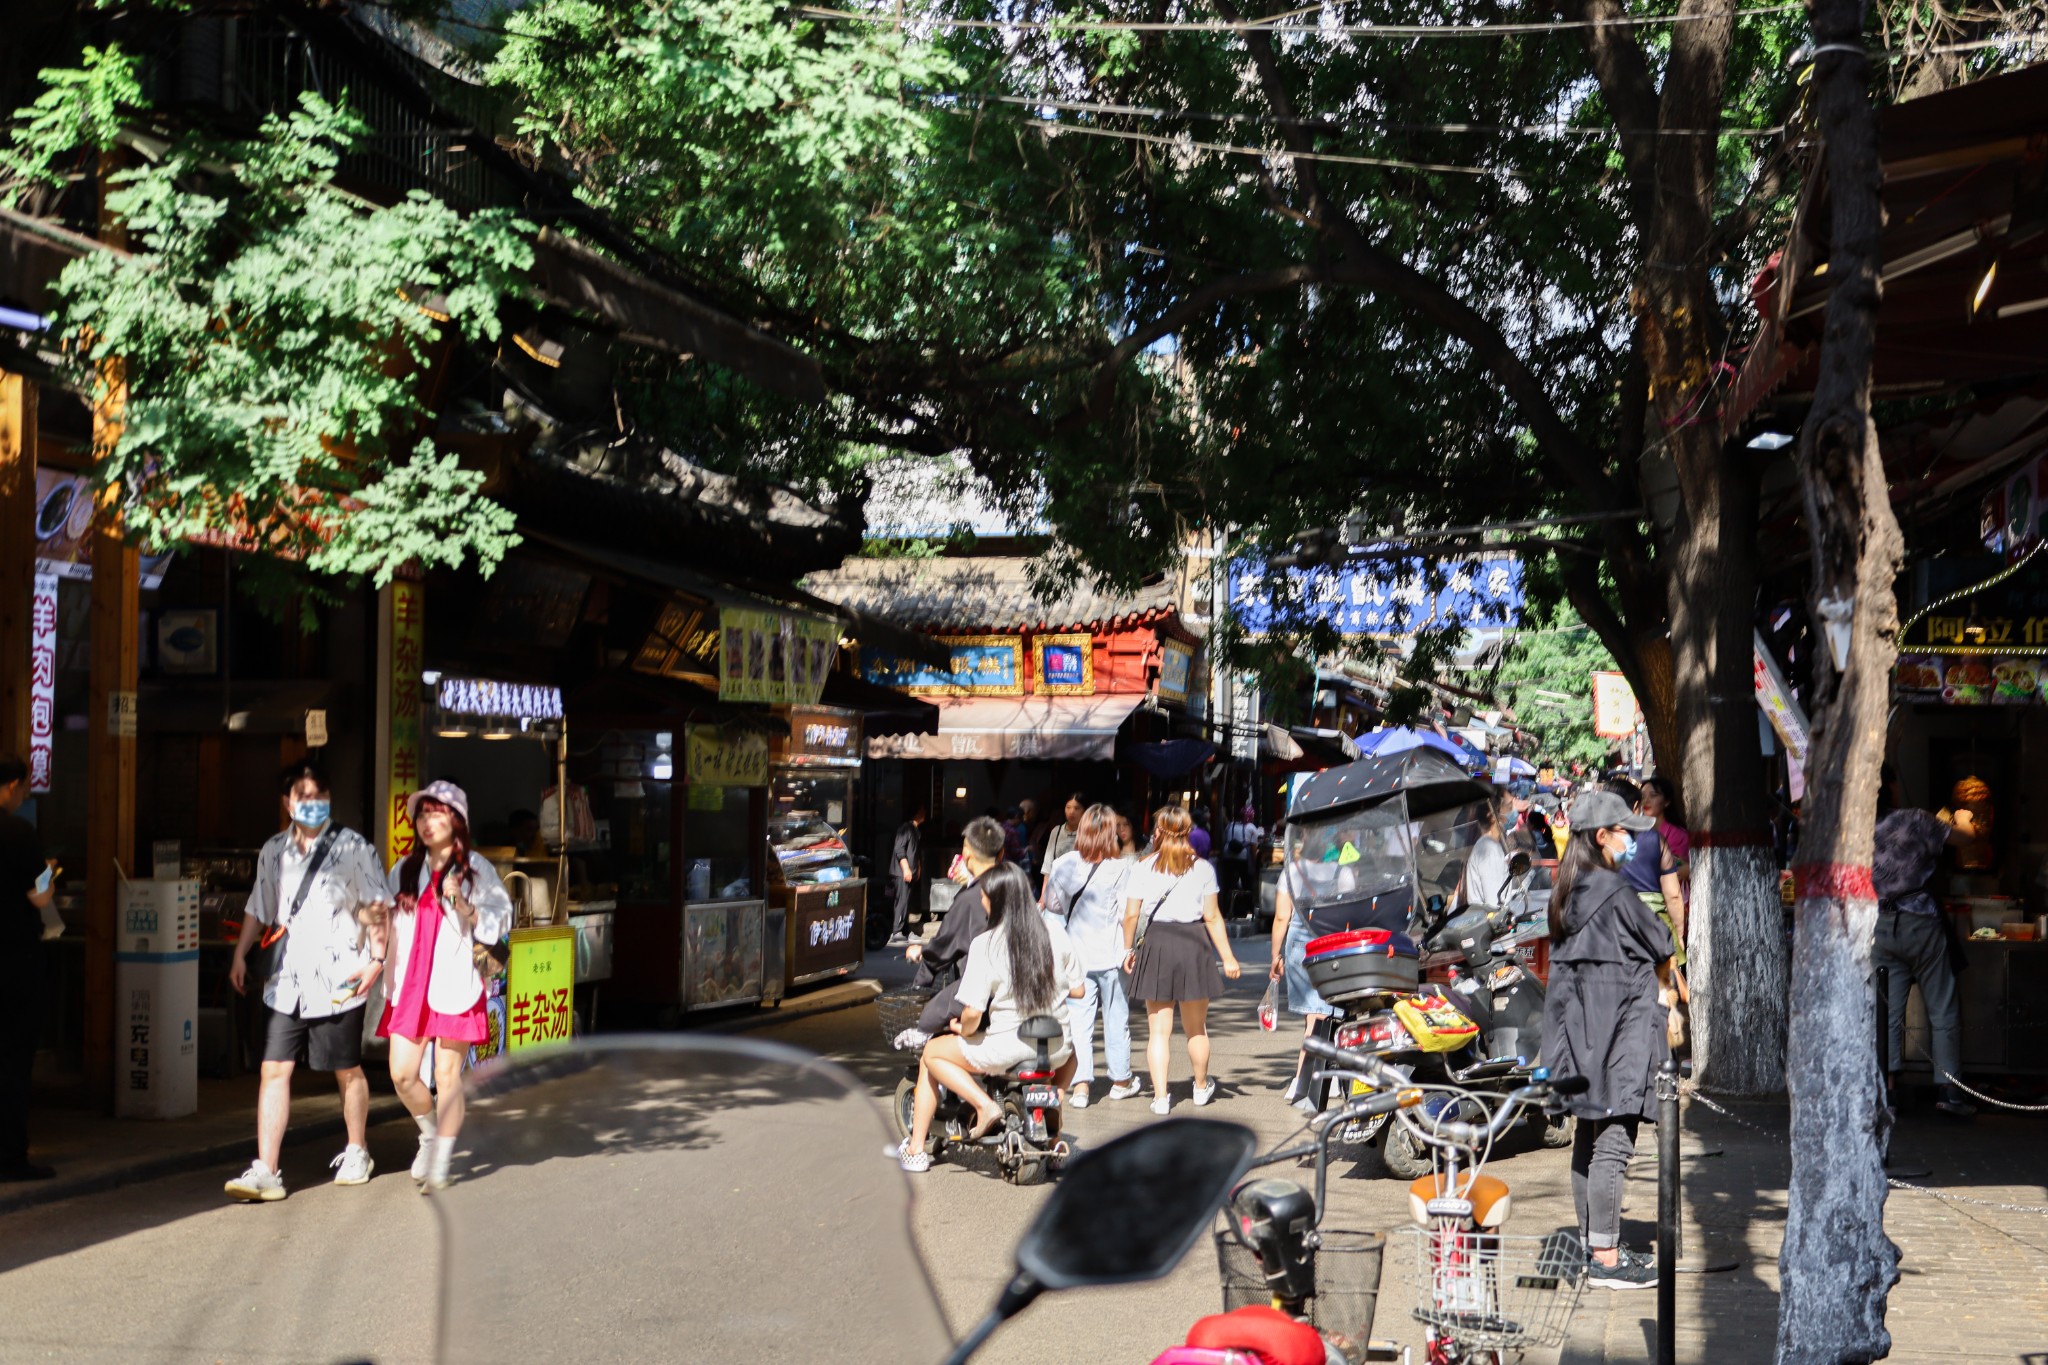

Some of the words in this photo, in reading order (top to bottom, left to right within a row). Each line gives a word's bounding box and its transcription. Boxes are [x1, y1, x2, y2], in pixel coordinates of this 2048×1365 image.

[393, 592, 419, 717] 羊杂汤
[512, 988, 569, 1046] 羊杂汤
[130, 1024, 150, 1090] 充电宝
